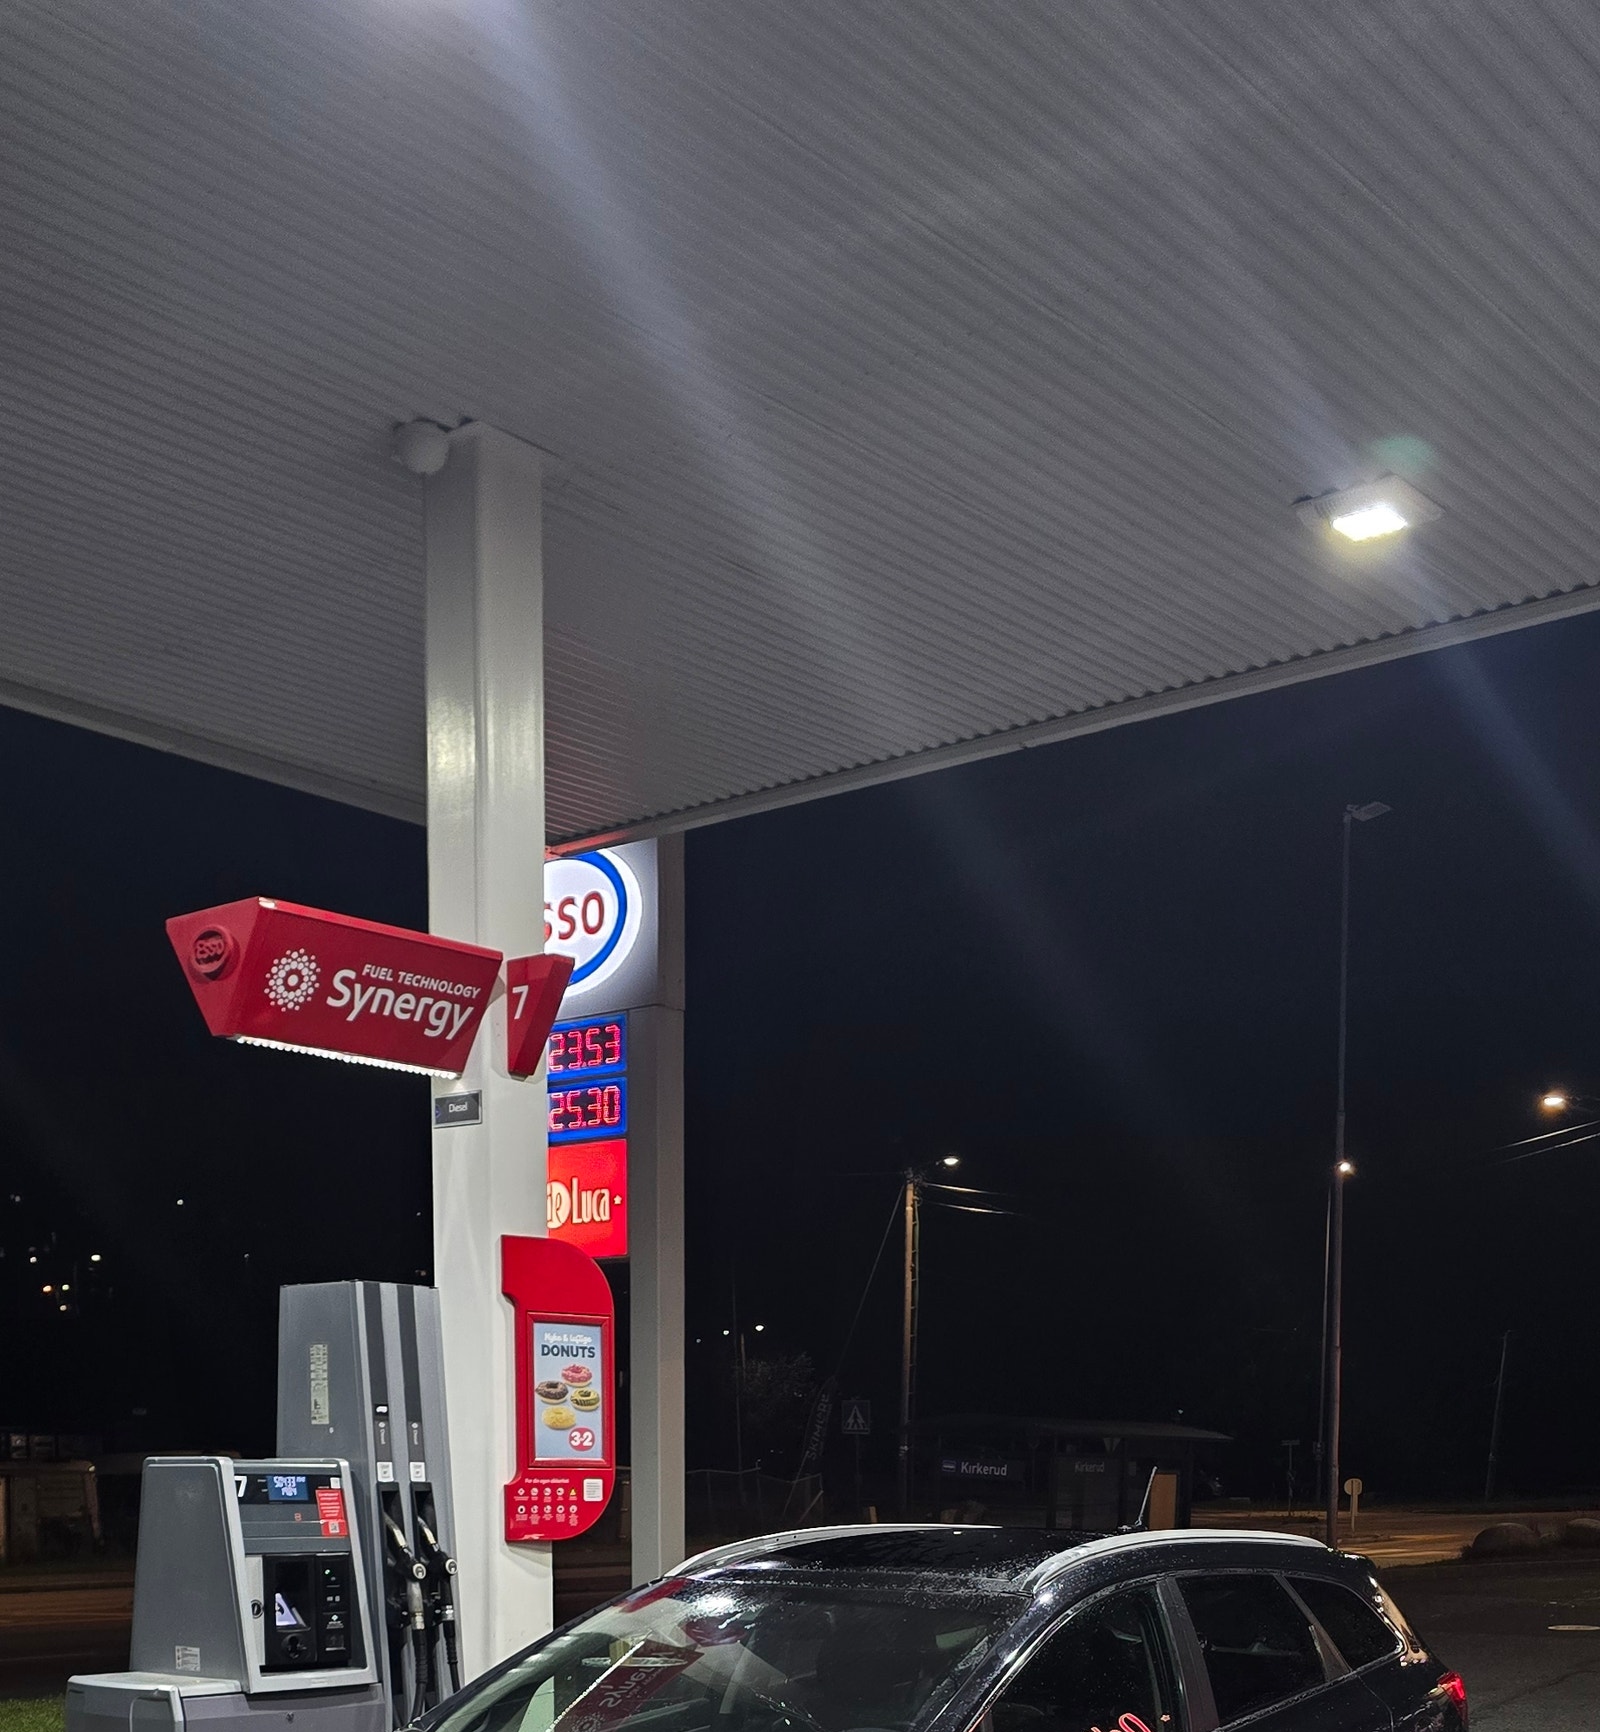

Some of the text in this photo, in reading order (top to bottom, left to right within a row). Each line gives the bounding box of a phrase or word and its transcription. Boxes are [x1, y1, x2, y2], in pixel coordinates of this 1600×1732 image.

[362, 964, 481, 999] FUEL TECHNOLOGY
[326, 969, 474, 1040] Synergy
[512, 985, 529, 1020] 7
[572, 1176, 611, 1224] Luca
[541, 1344, 596, 1358] DONUTS
[234, 1475, 247, 1497] 7
[961, 1461, 1008, 1476] Kirkerud
